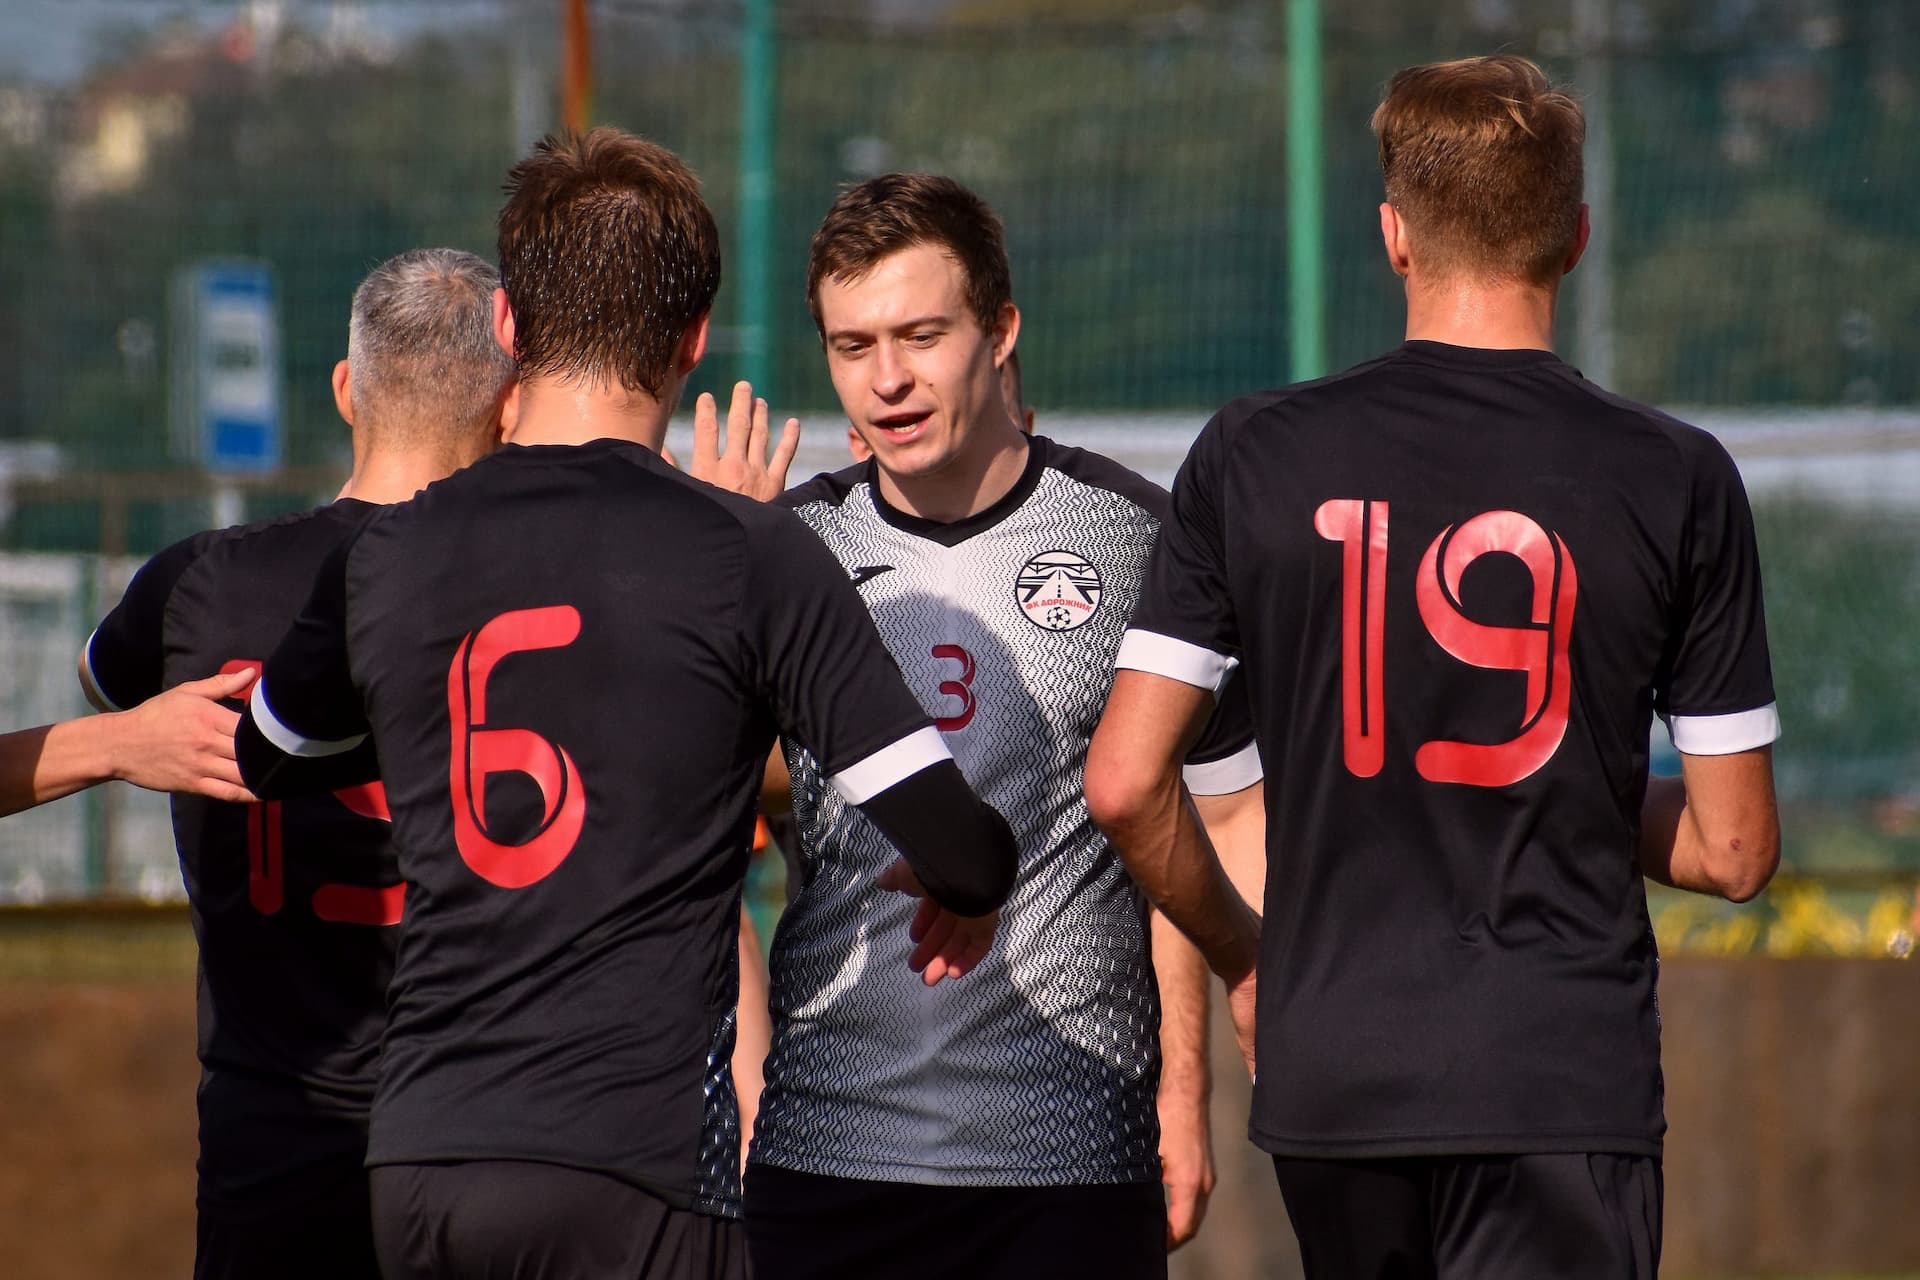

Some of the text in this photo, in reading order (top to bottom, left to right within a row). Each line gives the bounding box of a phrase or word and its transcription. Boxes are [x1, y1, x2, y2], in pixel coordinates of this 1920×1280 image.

[932, 644, 976, 732] 3
[1025, 599, 1092, 612] ФК ДОРОЖНИК
[1314, 499, 1578, 787] 19
[448, 605, 586, 889] 6
